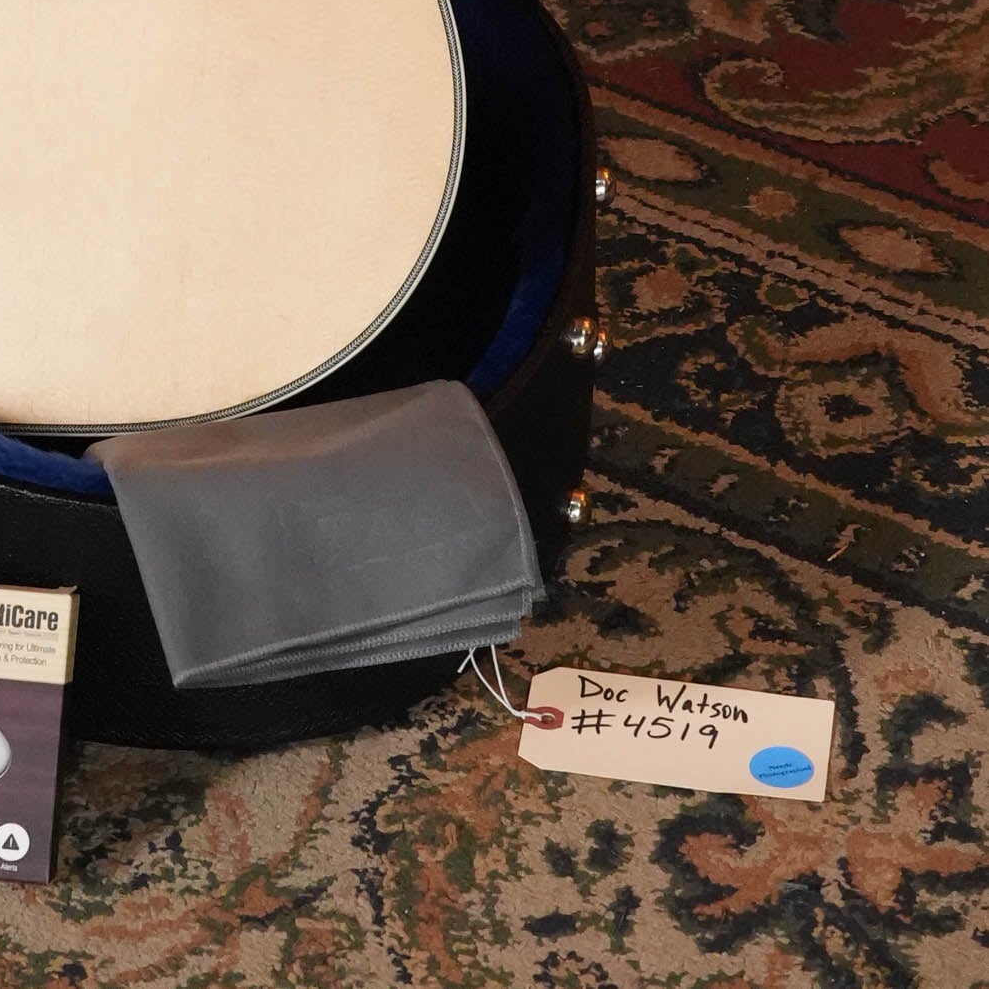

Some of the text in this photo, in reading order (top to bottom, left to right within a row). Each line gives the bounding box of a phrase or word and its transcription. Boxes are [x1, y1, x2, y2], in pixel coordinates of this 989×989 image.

[14, 641, 25, 651] for
[26, 642, 57, 654] Ultimate
[3, 653, 9, 663] &
[11, 654, 47, 666] Protection
[577, 675, 749, 724] Doc Watson
[0, 862, 18, 872] Alerts
